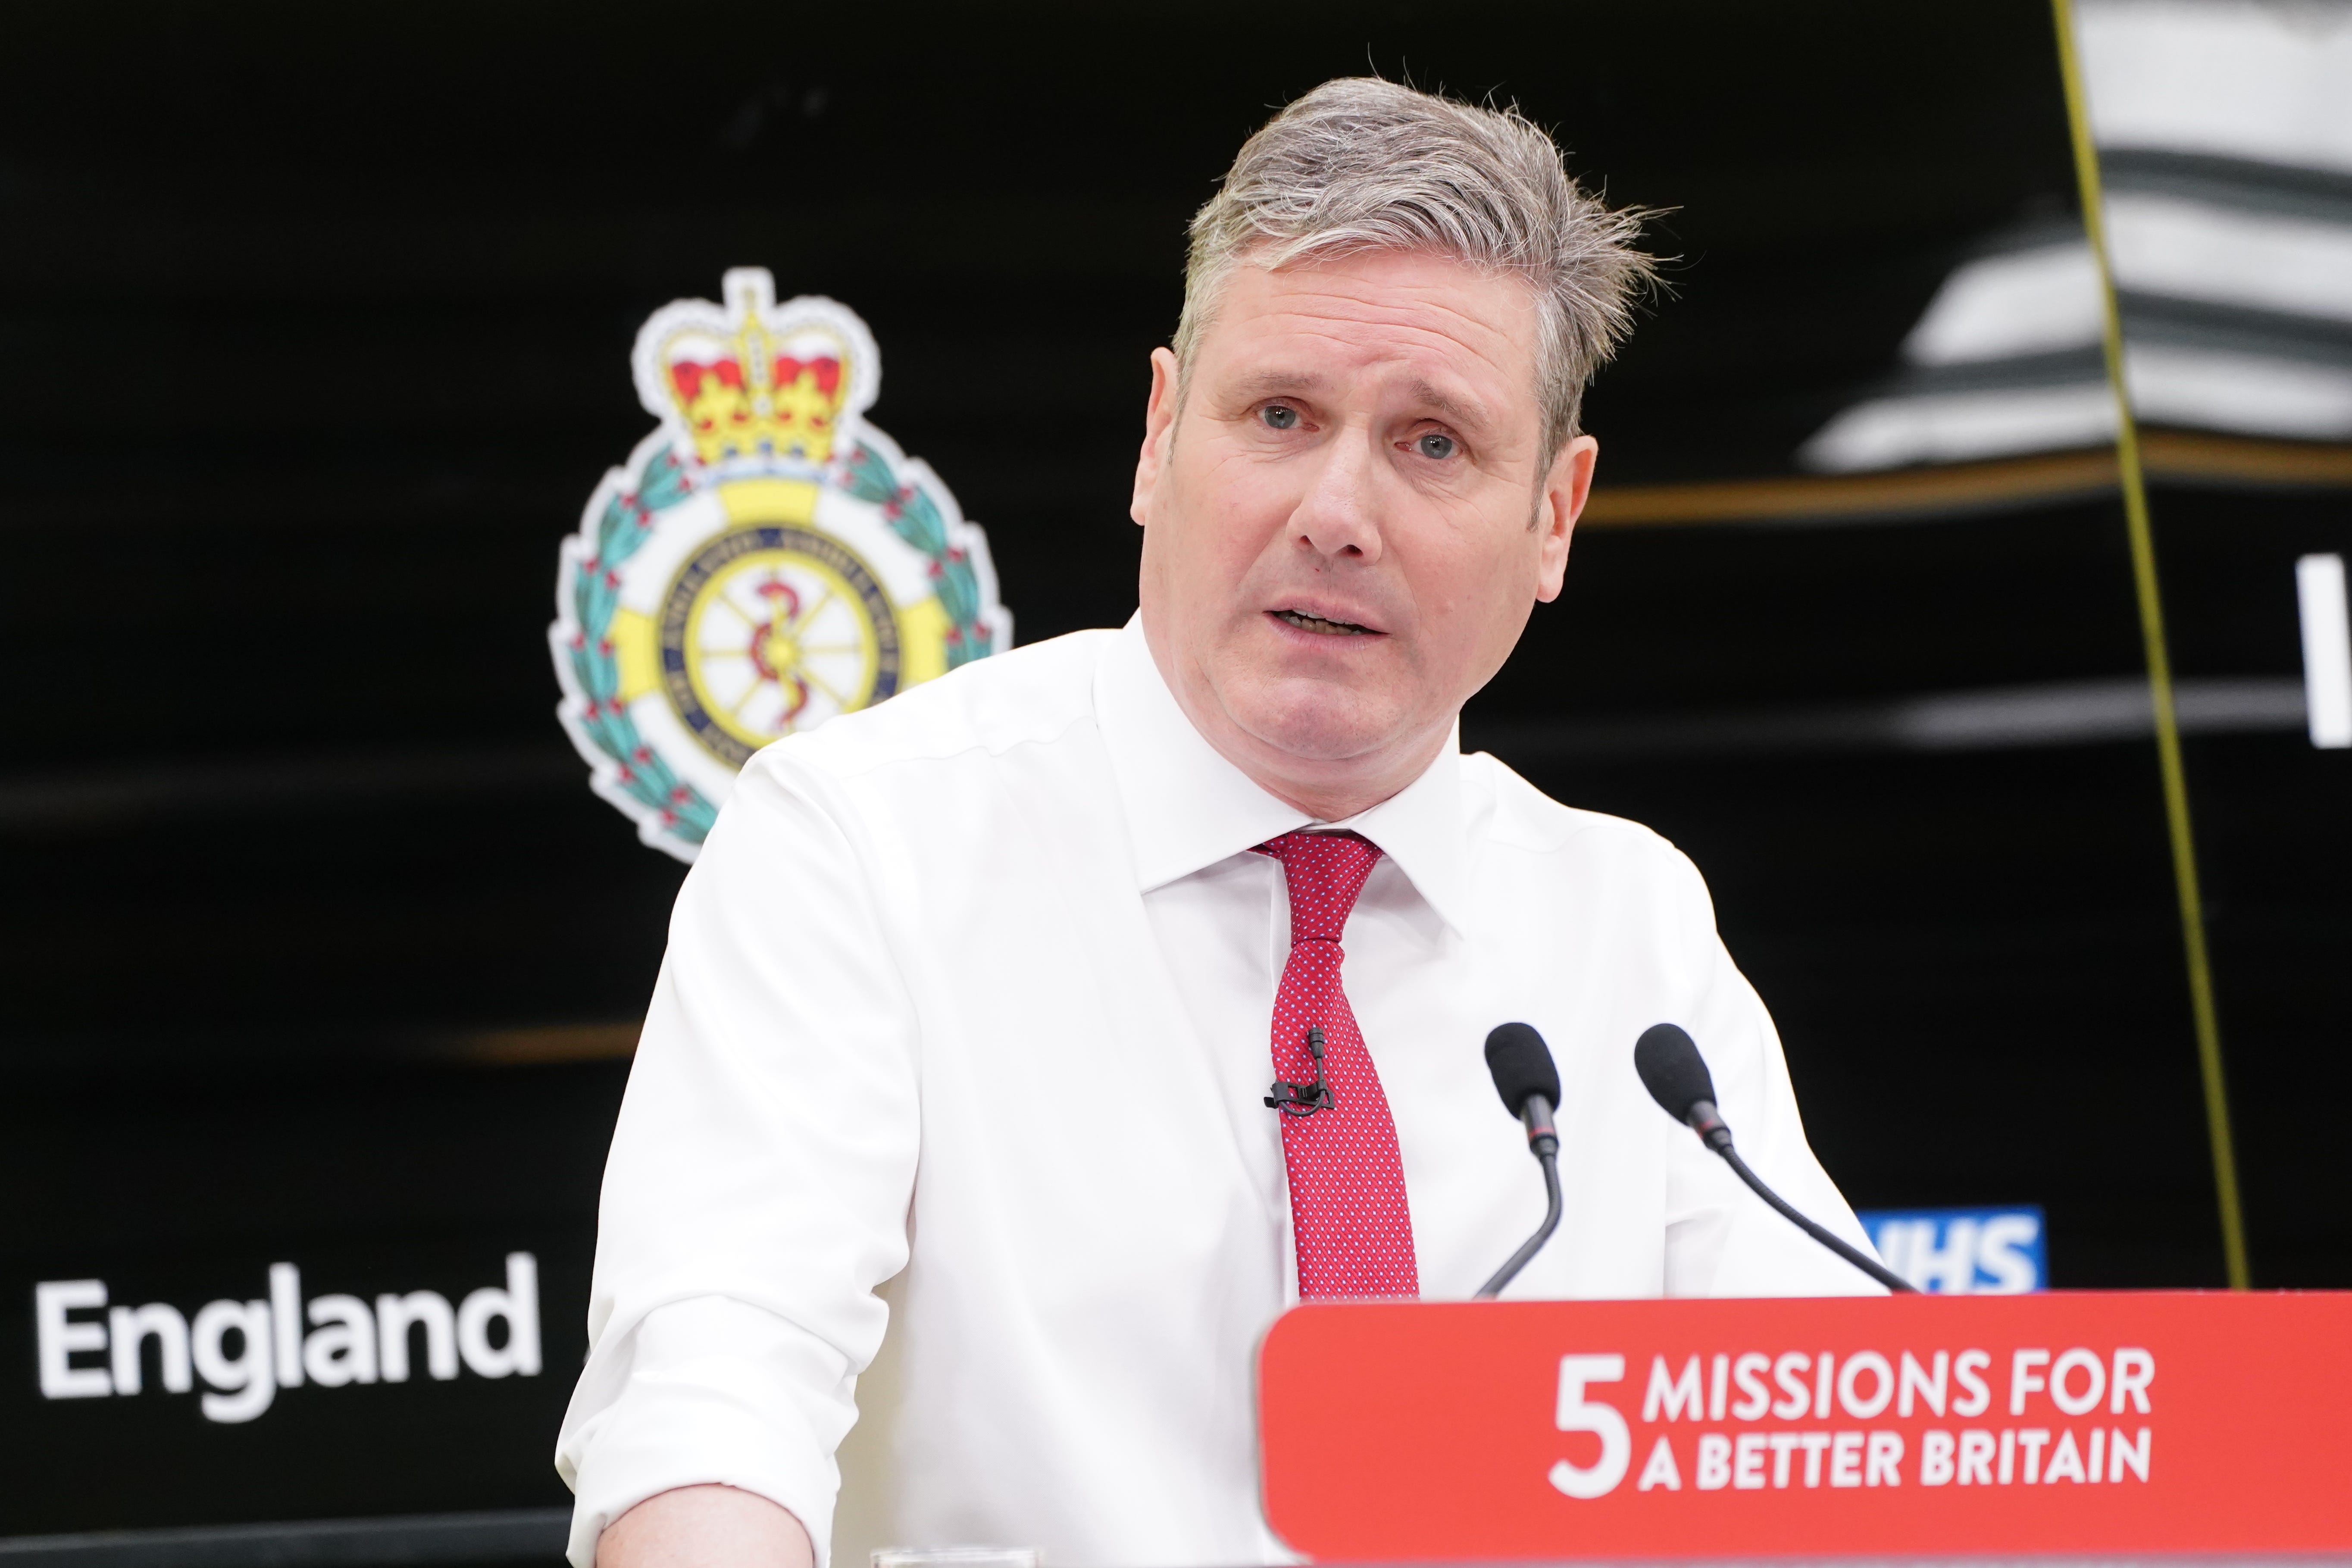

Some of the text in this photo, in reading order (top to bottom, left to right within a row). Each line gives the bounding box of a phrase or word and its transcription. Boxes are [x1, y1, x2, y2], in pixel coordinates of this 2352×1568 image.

[35, 1251, 542, 1424] England
[1548, 1348, 2155, 1499] 5 MISSIONS FOR
[1638, 1427, 2152, 1492] A BETTER BRITAIN
